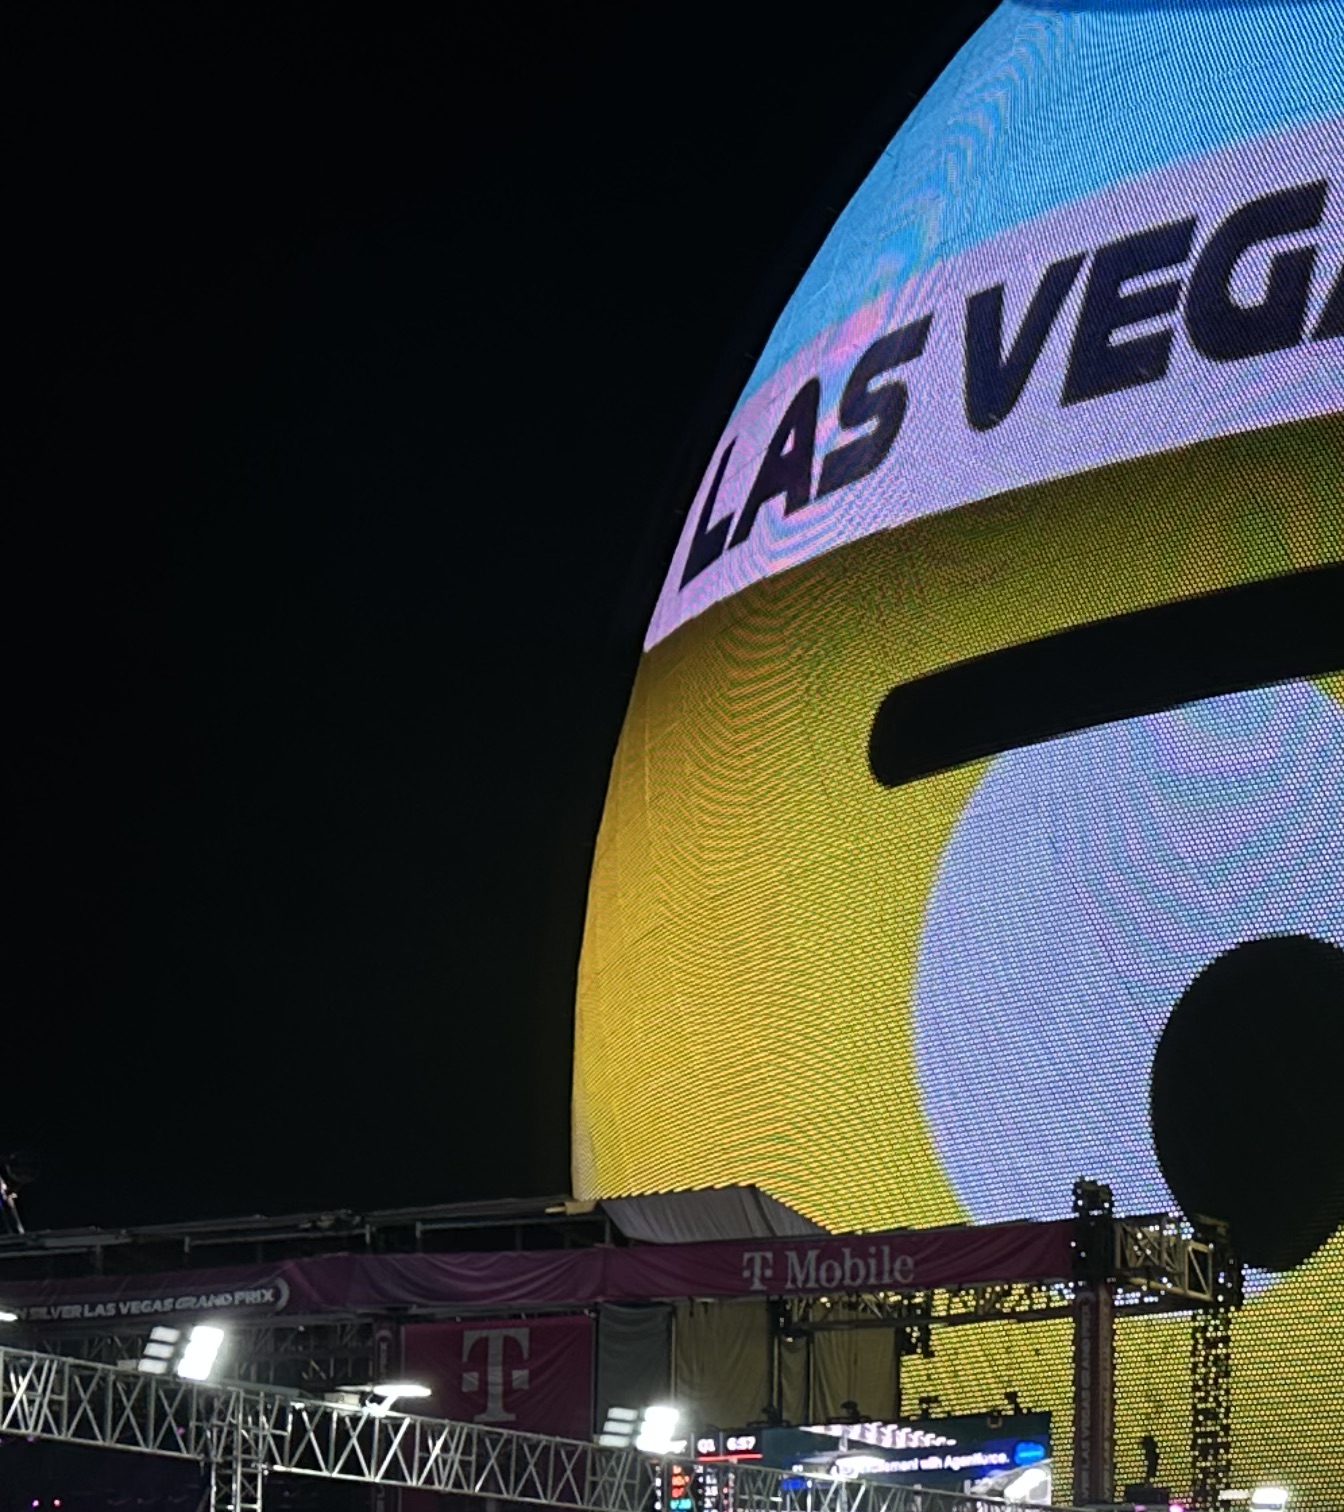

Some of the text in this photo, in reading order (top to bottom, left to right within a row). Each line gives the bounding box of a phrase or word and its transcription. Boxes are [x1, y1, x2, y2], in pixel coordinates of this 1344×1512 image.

[679, 313, 933, 591] LAS
[784, 1245, 914, 1290] Mobile
[84, 1303, 116, 1318] LAS
[118, 1297, 174, 1315] VEGAS
[175, 1293, 233, 1310] GRAND
[233, 1288, 276, 1305] PRIX
